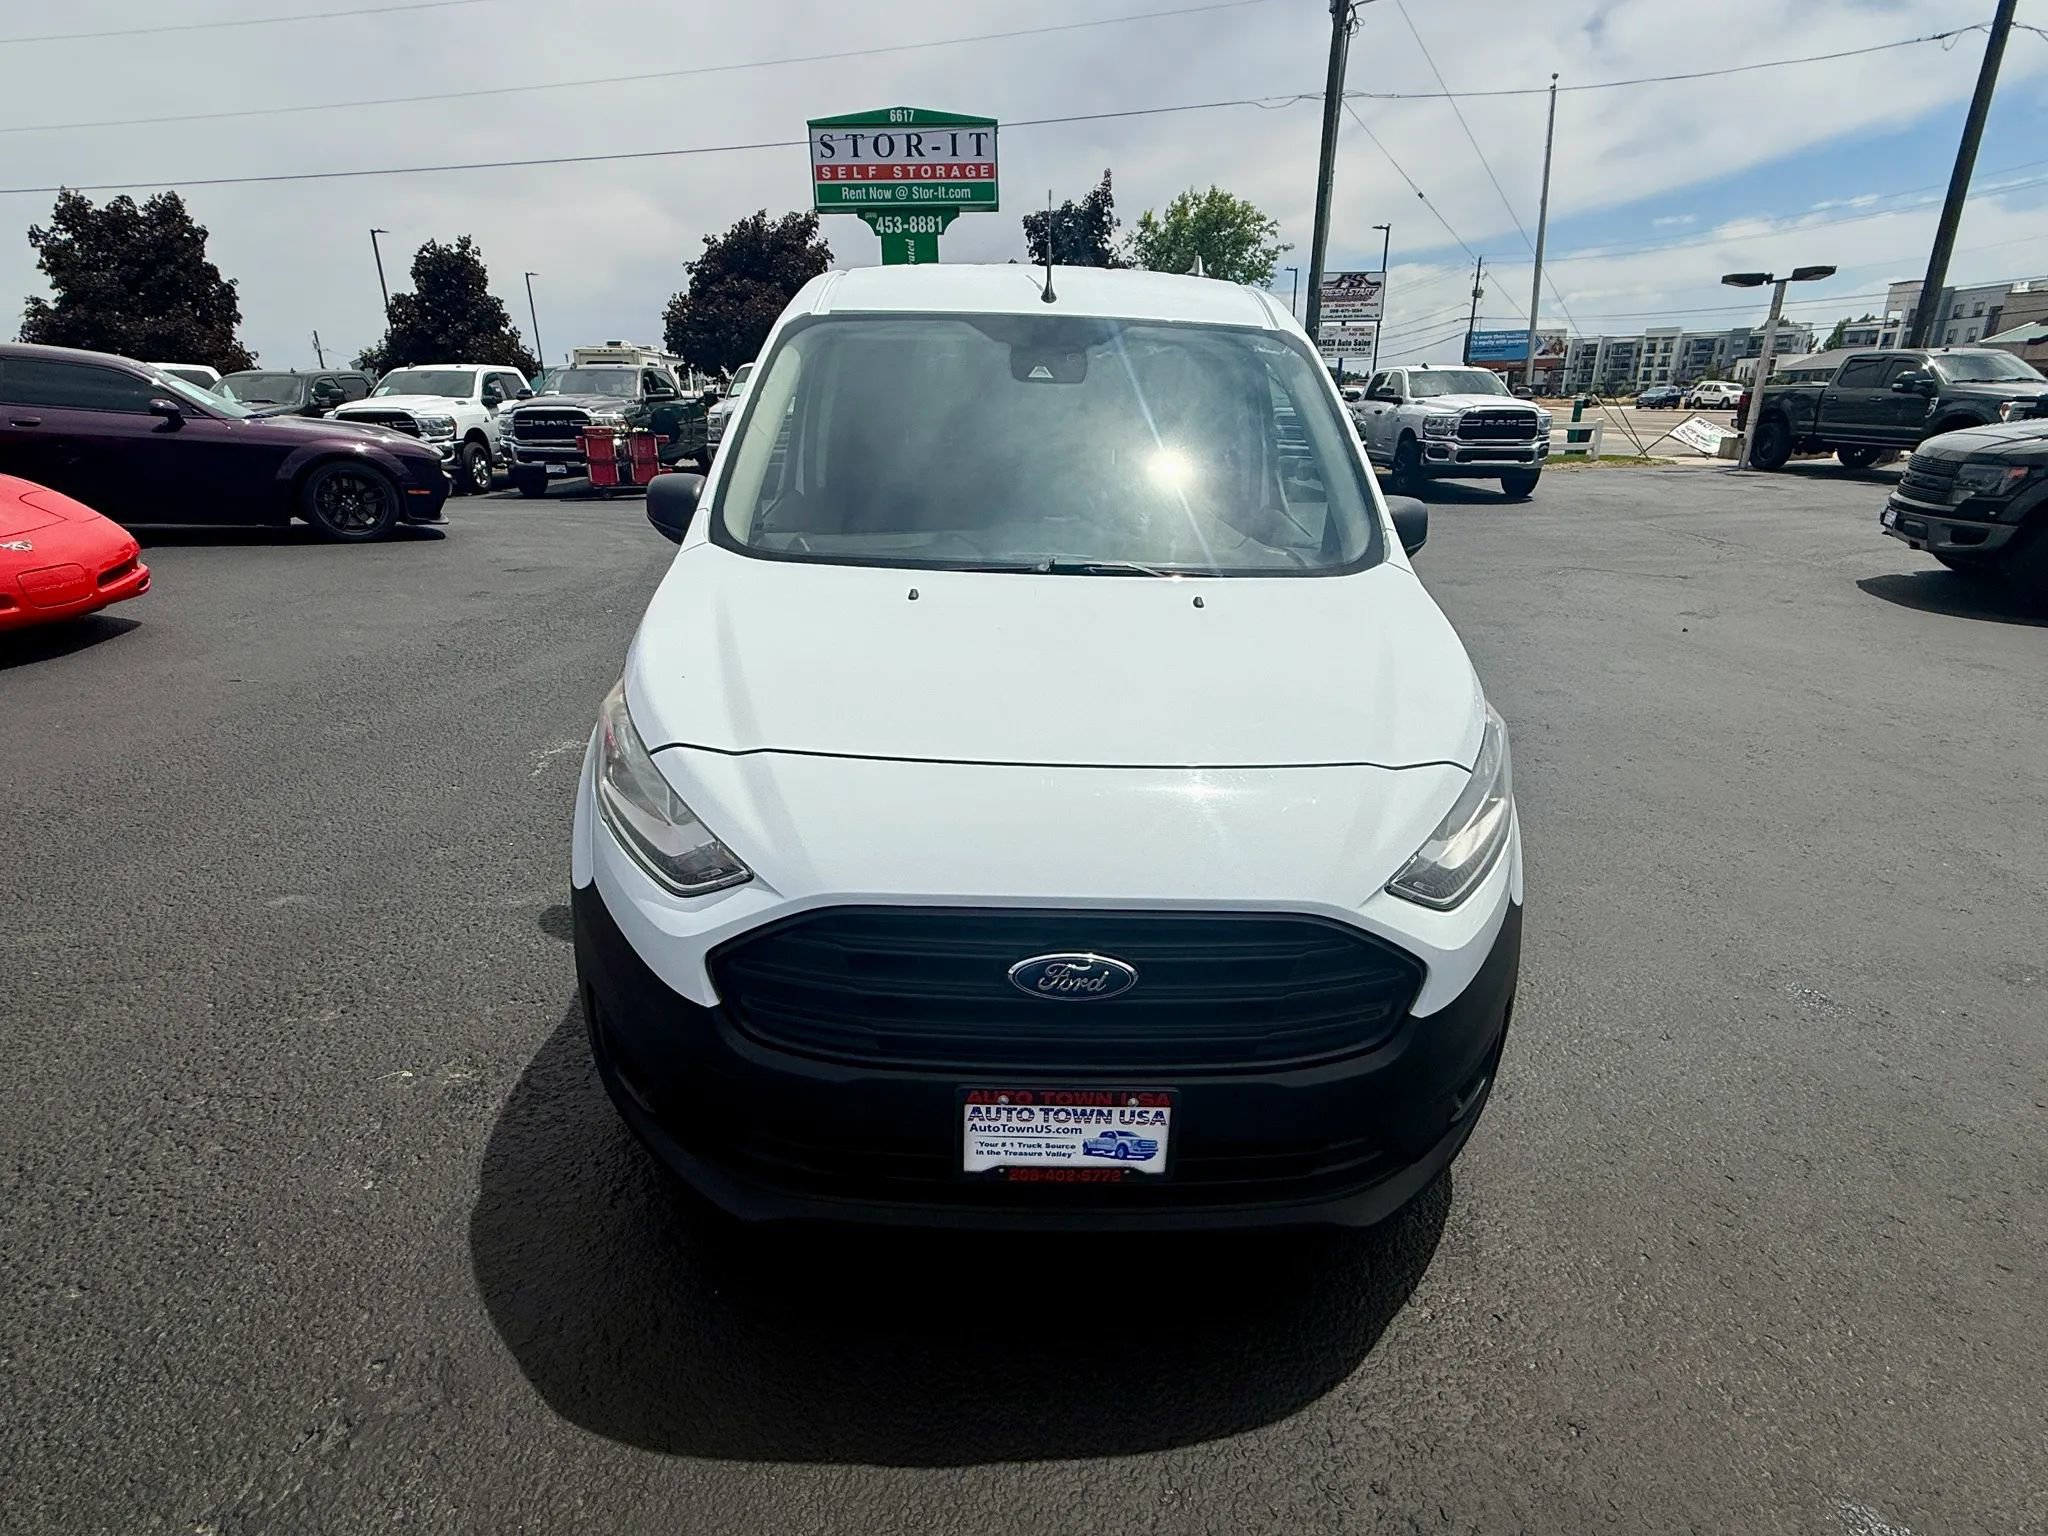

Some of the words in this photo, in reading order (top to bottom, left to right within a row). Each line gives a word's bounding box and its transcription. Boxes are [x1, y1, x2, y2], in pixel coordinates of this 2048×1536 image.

[889, 109, 915, 122] 6617
[820, 132, 989, 158] STOR-IT
[821, 166, 877, 179] SELF
[892, 165, 989, 178] STORAGE
[841, 187, 867, 200] Rent
[869, 186, 892, 199] Now
[895, 185, 909, 200] @
[876, 215, 944, 233] 453-8881
[1348, 287, 1379, 296] START
[1337, 339, 1352, 347] Auto
[1353, 339, 1371, 347] Sales
[534, 419, 568, 427] RAM
[1038, 962, 1110, 992] Ford
[967, 1089, 1034, 1105] AUTO
[1039, 1091, 1113, 1106] TOWN
[1120, 1092, 1171, 1106] USA
[968, 1106, 1036, 1122] AUTO
[1038, 1107, 1113, 1124] TOWN
[1119, 1109, 1167, 1126] USA
[969, 1123, 1082, 1135] AutoTownUS.com
[1045, 1142, 1077, 1150] Source
